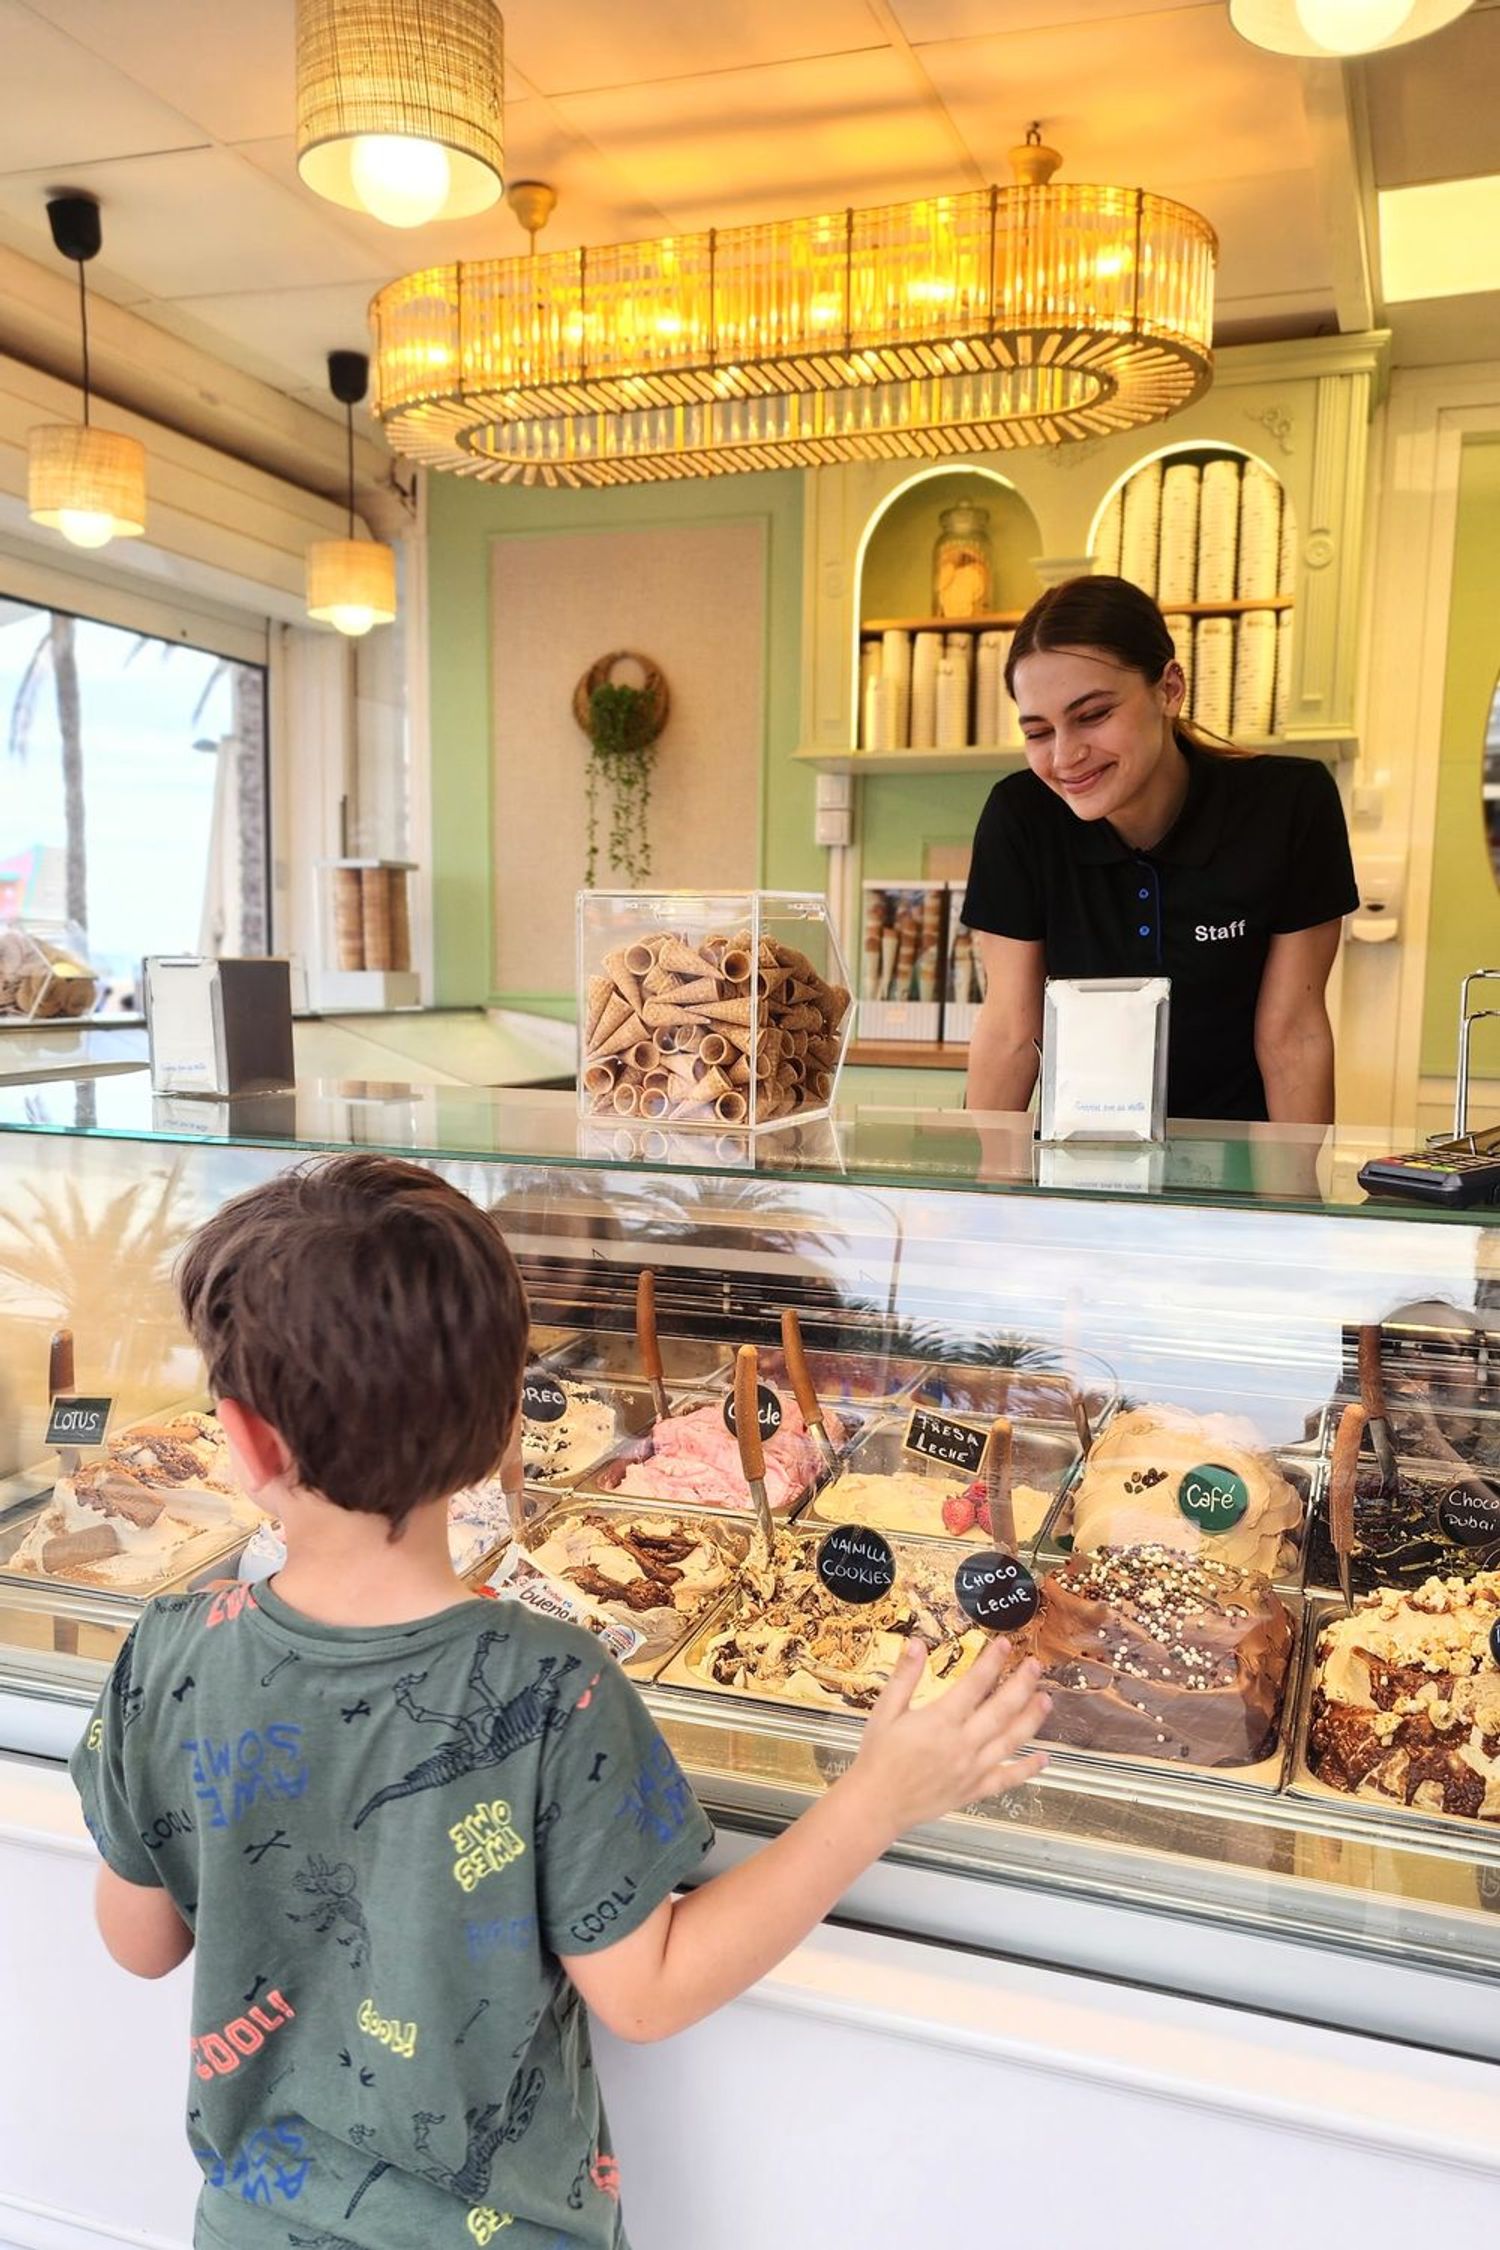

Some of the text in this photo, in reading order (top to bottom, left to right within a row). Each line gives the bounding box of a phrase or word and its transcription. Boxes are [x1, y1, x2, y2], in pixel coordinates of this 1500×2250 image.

[1195, 919, 1246, 942] Staff
[522, 1386, 566, 1405] REO
[53, 1410, 100, 1431] LOTUS
[915, 1432, 970, 1463] LECHE
[1186, 1483, 1236, 1513] Café
[1448, 1489, 1500, 1511] Choco
[822, 1559, 892, 1585] COOKIES
[962, 1565, 1018, 1591] CHOCO
[519, 1586, 570, 1620] bueno
[976, 1588, 1032, 1616] LECHE
[571, 1876, 637, 1943] COOL!
